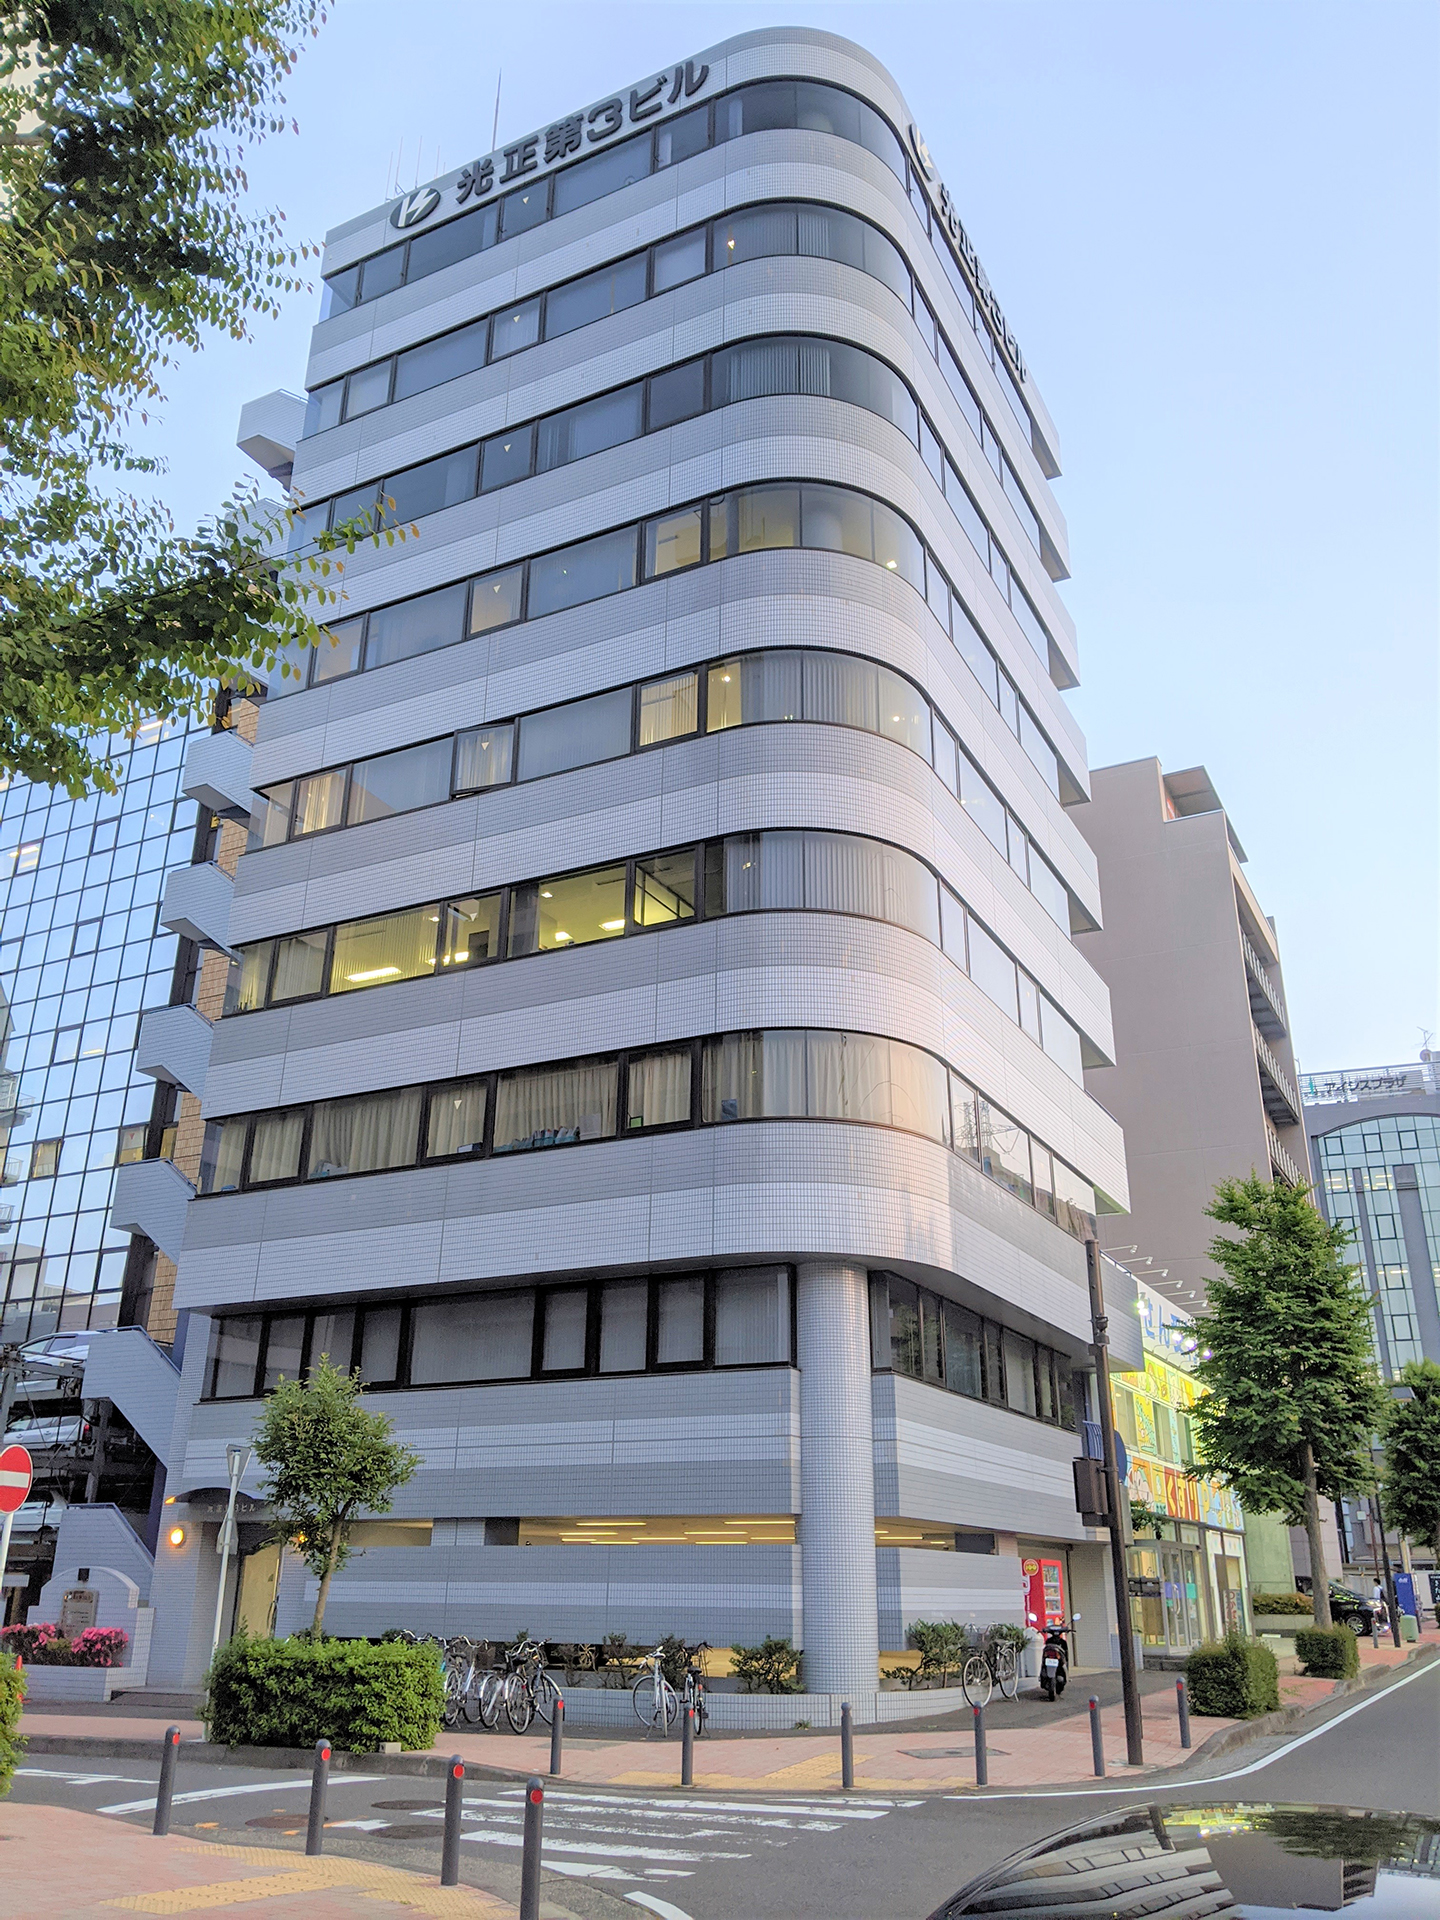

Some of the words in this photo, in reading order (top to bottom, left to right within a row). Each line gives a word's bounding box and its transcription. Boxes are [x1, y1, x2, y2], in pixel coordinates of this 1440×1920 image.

[455, 60, 710, 204] 光正第3ビル
